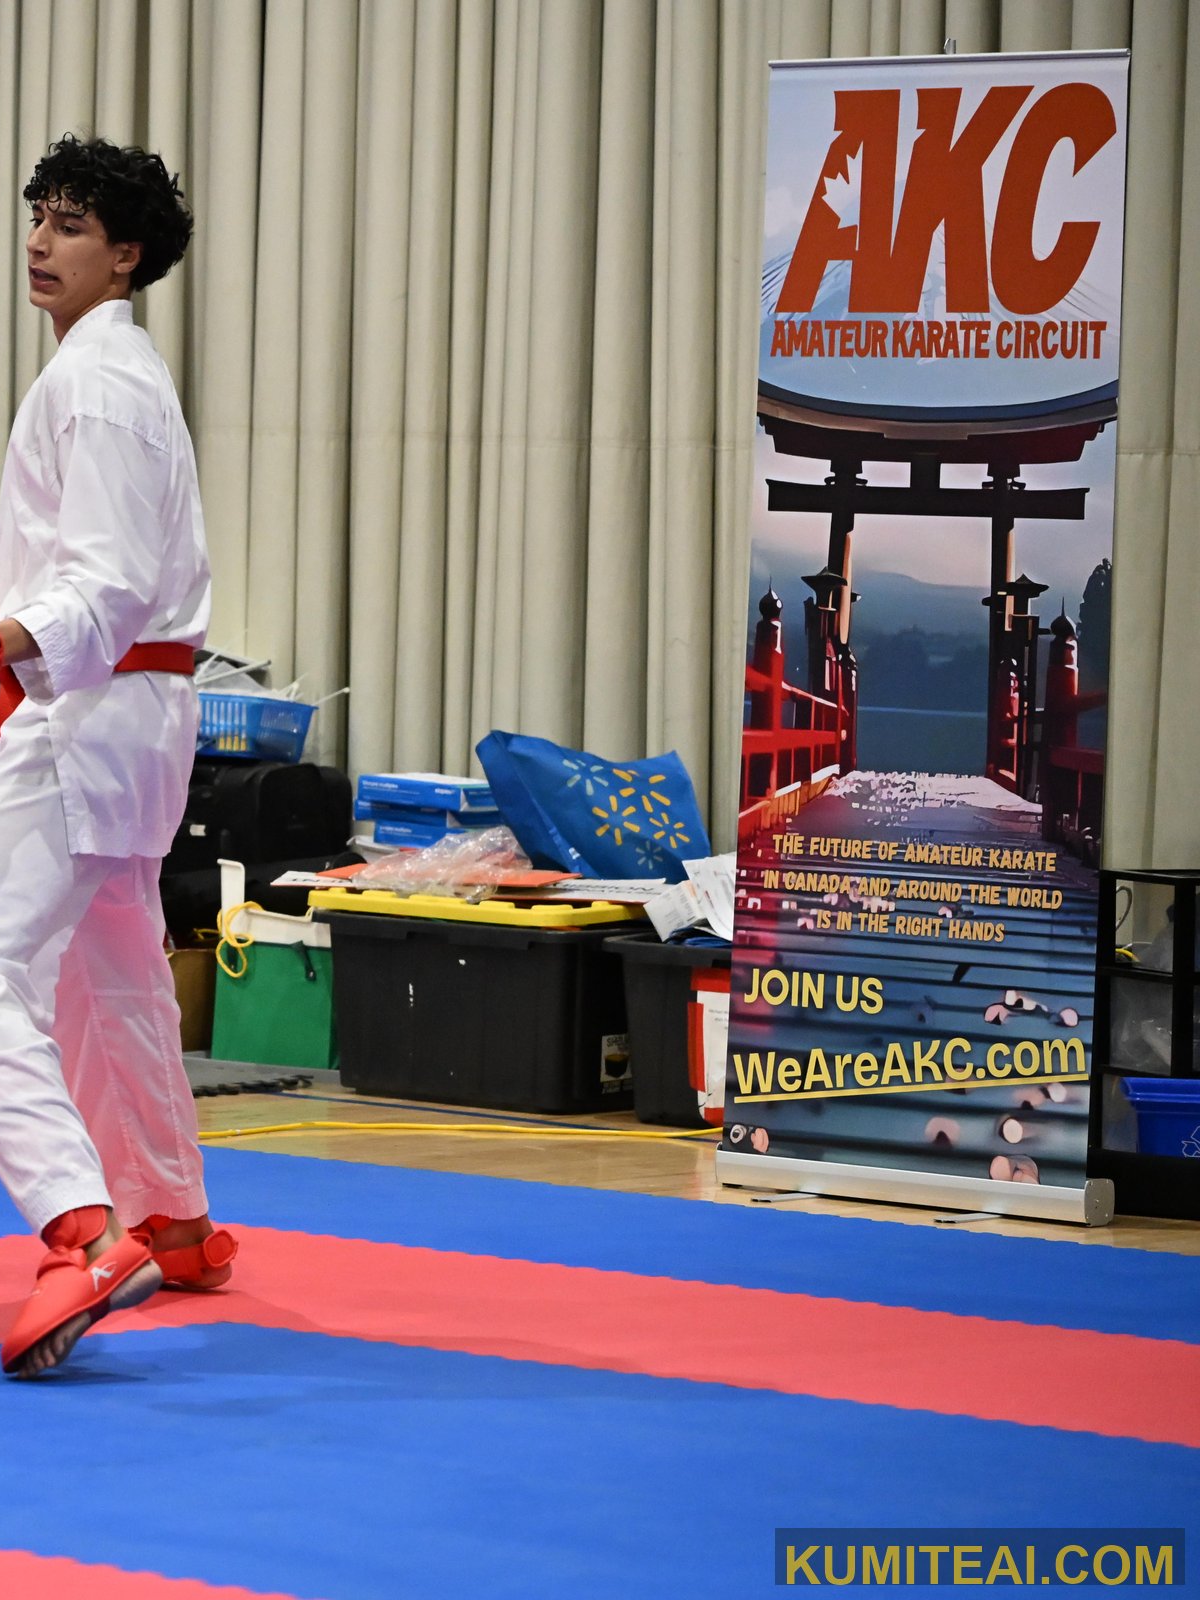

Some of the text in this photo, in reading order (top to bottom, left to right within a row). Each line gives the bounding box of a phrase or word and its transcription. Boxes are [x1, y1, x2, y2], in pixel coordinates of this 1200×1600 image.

[775, 82, 1117, 315] AKC
[770, 320, 1107, 359] AMATEUR KARATE CIRCUIT
[772, 834, 1057, 872] THE FUTURE OF AMATEUR KARATE
[763, 870, 1063, 910] IN CANADA AND AROUND THE WORLD
[816, 910, 1005, 942] IS IN THE RIGHT HANDS
[744, 968, 884, 1014] JOIN US
[733, 1037, 1086, 1095] WeAreAKC.com
